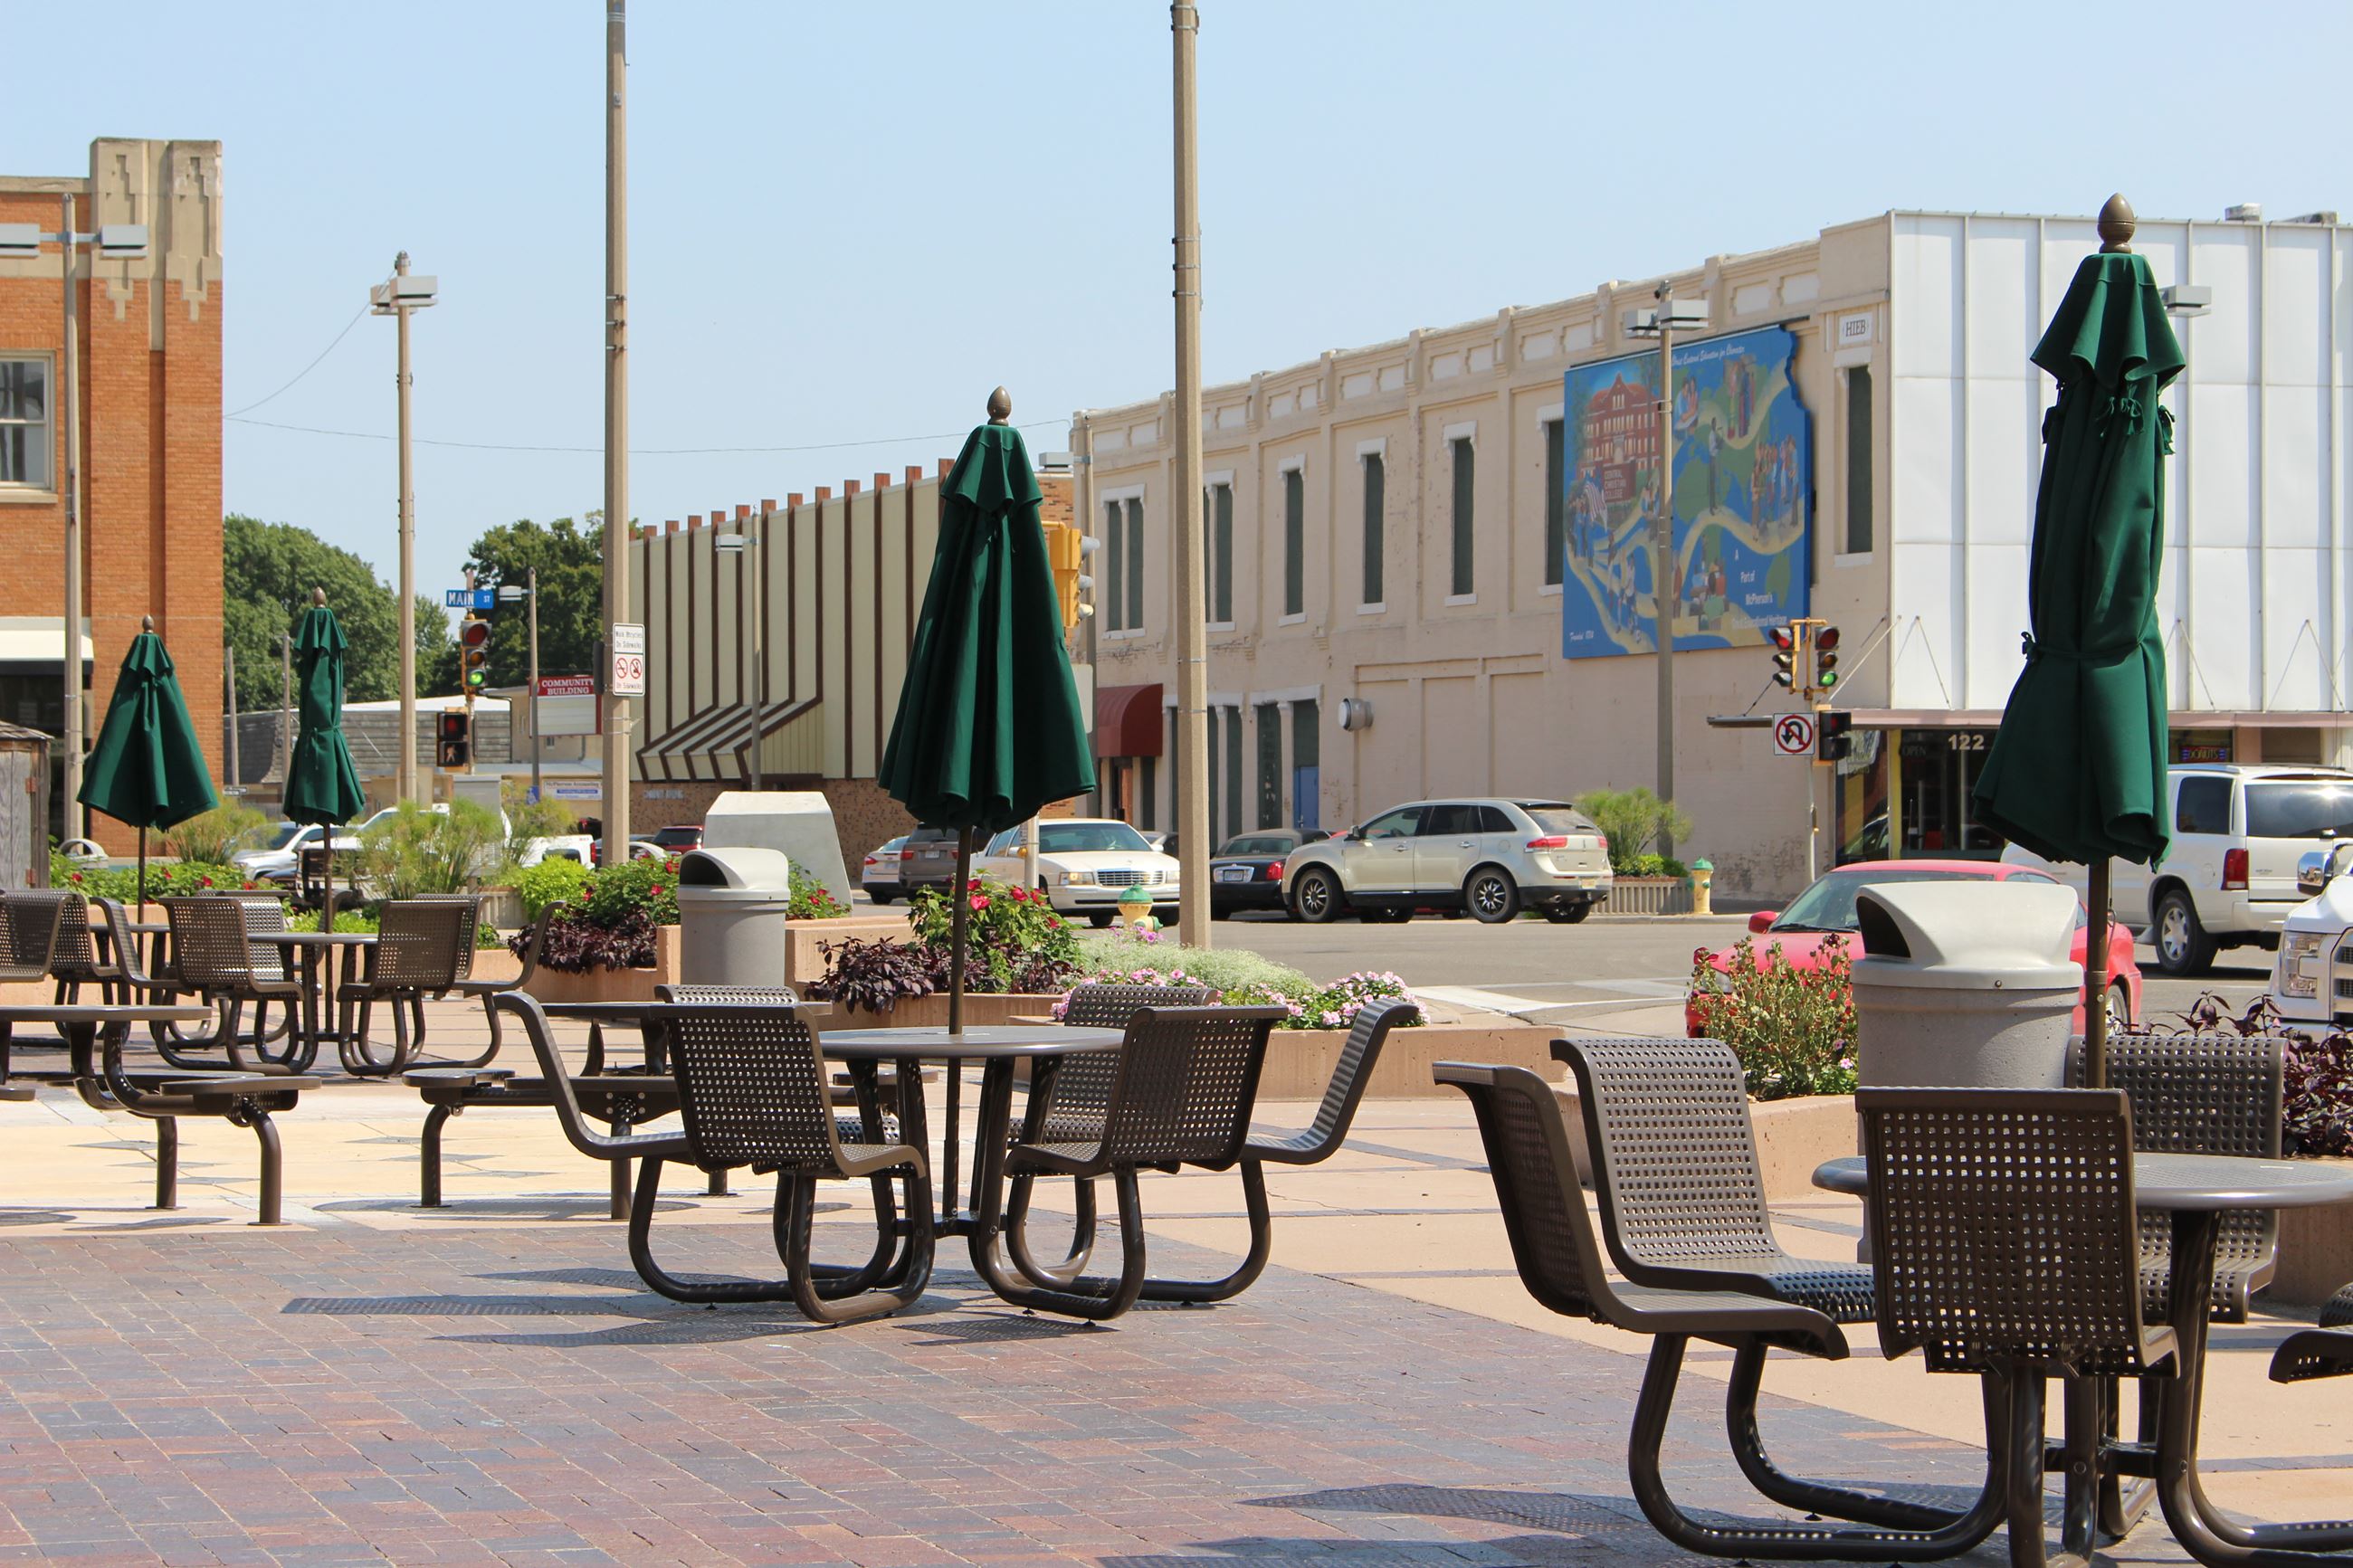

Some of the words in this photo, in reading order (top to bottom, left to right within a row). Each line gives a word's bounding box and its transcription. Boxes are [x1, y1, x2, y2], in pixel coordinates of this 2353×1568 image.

[1846, 319, 1866, 337] HIEB
[1735, 549, 1739, 561] A
[448, 592, 474, 605] MAIN
[483, 594, 491, 603] ST
[541, 679, 595, 688] COMMUNITY
[548, 687, 589, 696] BUILDING
[1948, 734, 1985, 751] 122
[1902, 746, 1926, 757] OPEN
